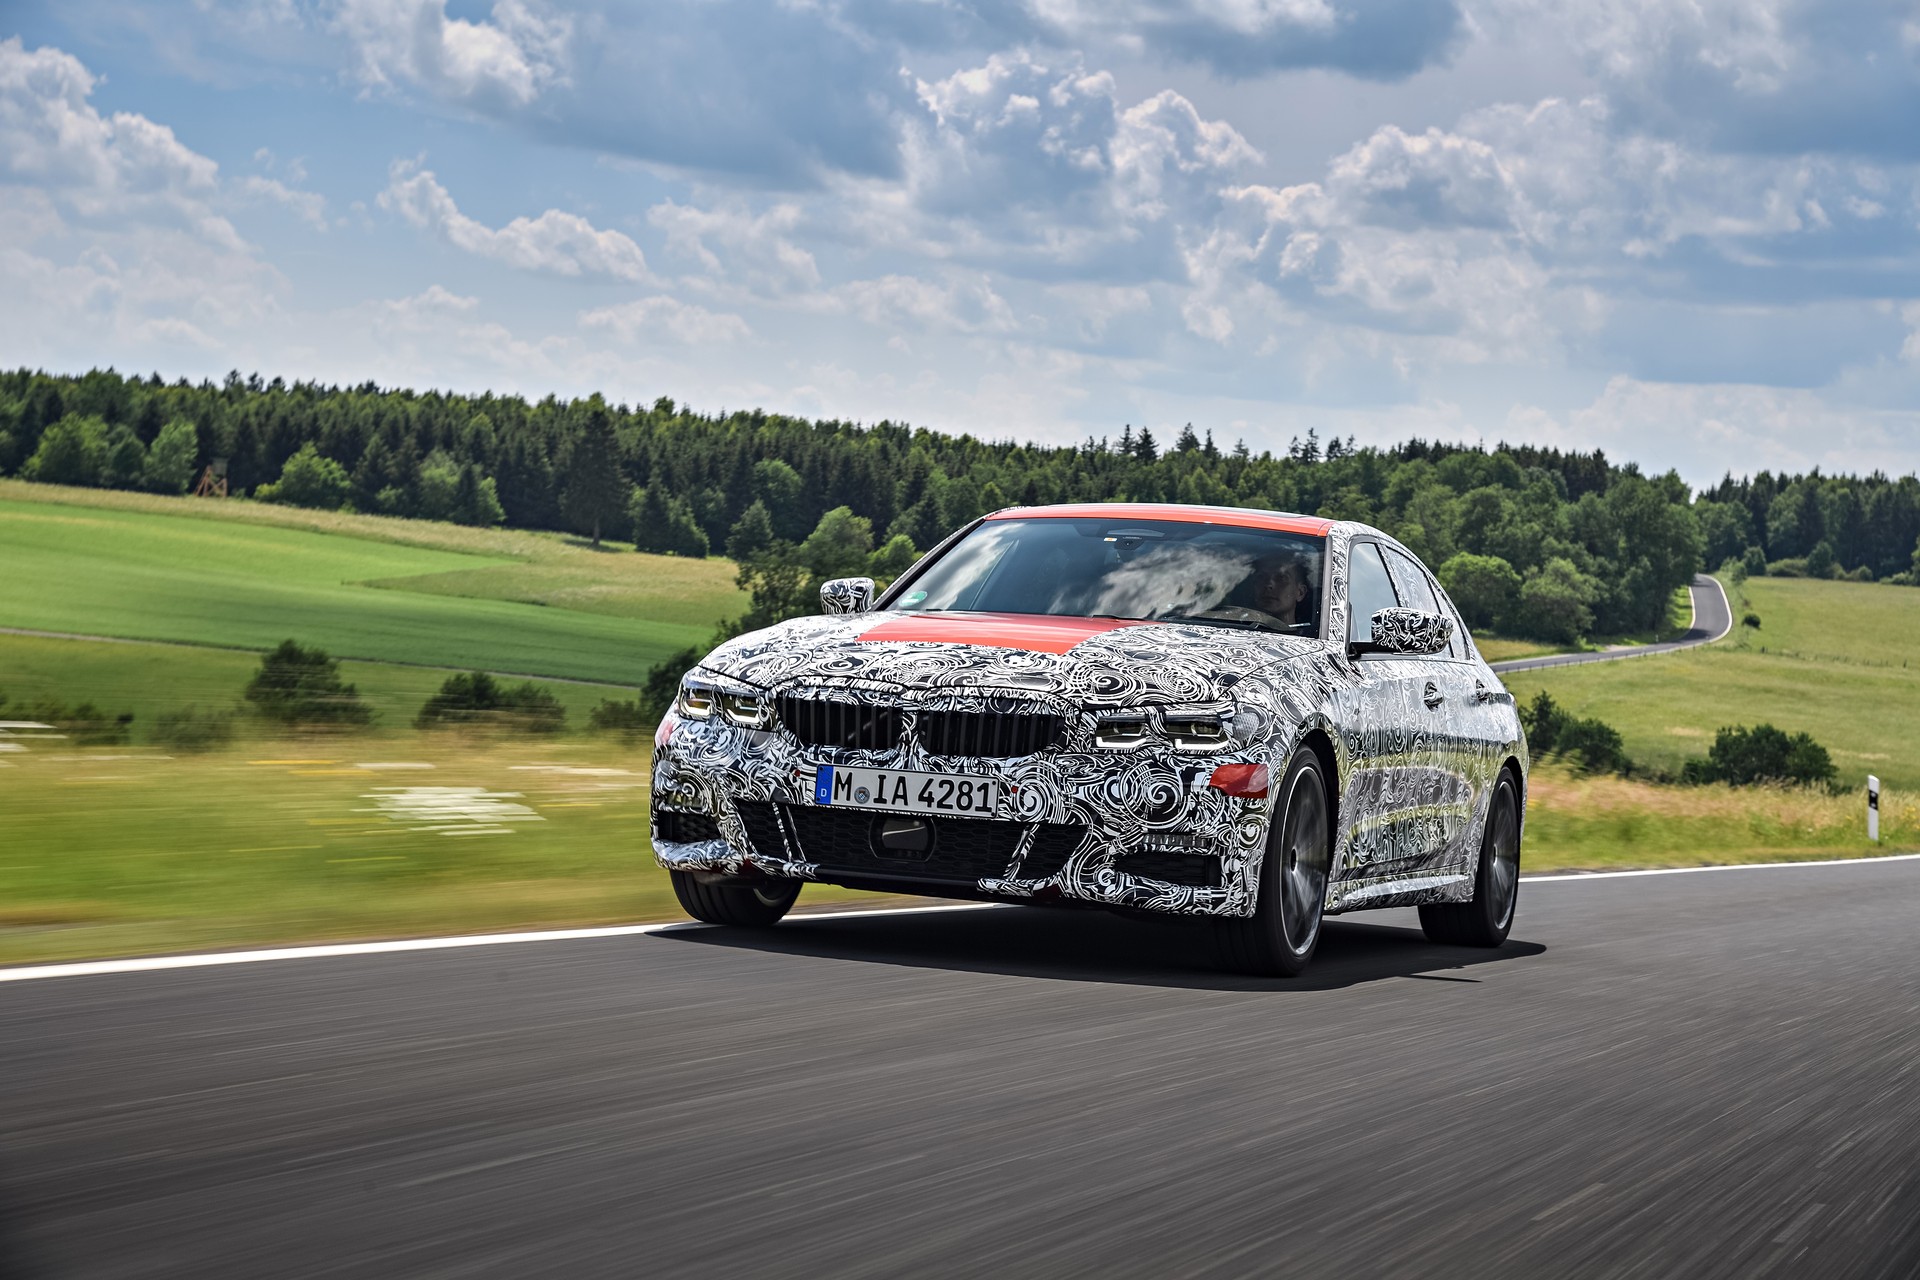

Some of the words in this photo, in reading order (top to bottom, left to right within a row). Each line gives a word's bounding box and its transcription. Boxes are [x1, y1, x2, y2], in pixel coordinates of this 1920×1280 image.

[820, 788, 827, 797] D
[834, 771, 852, 801] M
[873, 775, 908, 806] IA
[918, 778, 992, 812] 4281
